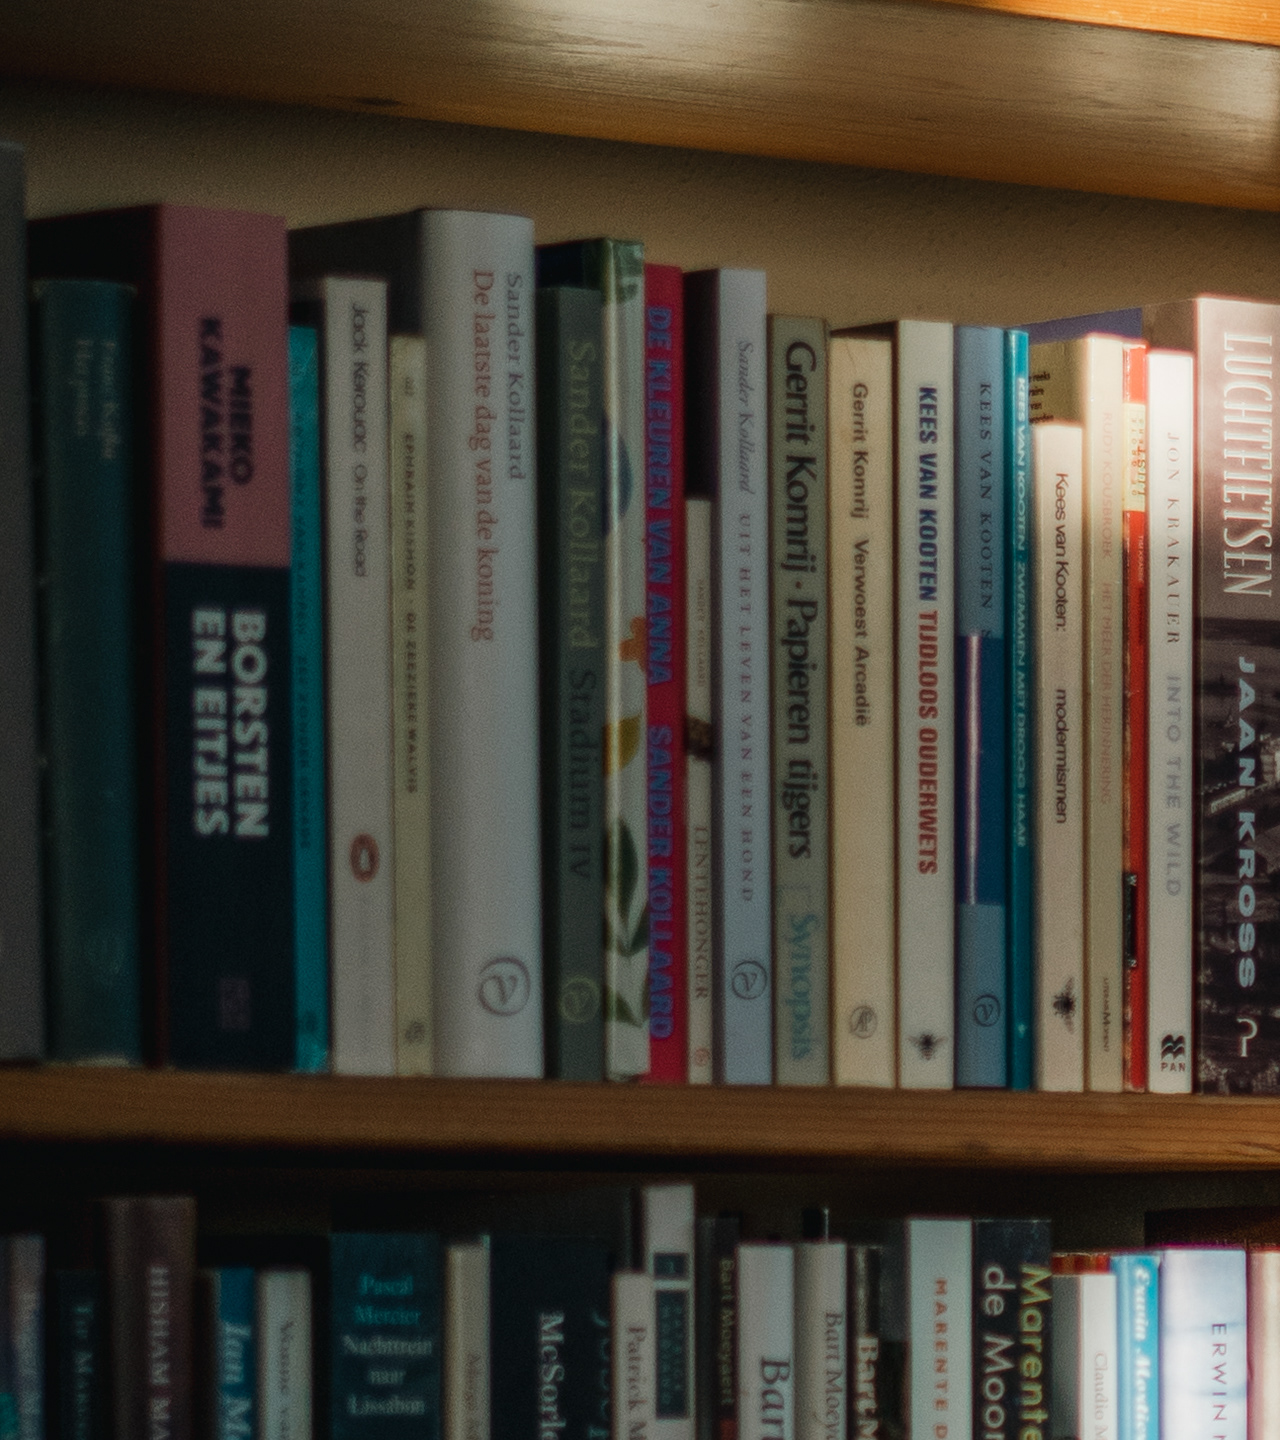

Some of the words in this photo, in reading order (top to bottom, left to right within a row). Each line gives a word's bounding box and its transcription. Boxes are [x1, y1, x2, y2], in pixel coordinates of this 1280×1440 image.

[199, 316, 225, 533] KAWAKAMI
[228, 364, 253, 487] MIEKO
[917, 452, 939, 502] VAN
[918, 385, 939, 446] KEES
[1223, 332, 1273, 598] LUCHTFIETSEN
[917, 509, 939, 602] KOOTEN
[190, 605, 225, 674] EN
[917, 611, 939, 720] TIJDLOOS
[190, 688, 229, 839] EITJES
[230, 610, 269, 839] BORSTEN
[1238, 656, 1257, 788] JAAN
[917, 724, 939, 875] OUDERWETS
[1238, 810, 1257, 989] KROSS
[982, 1265, 1016, 1317] de
